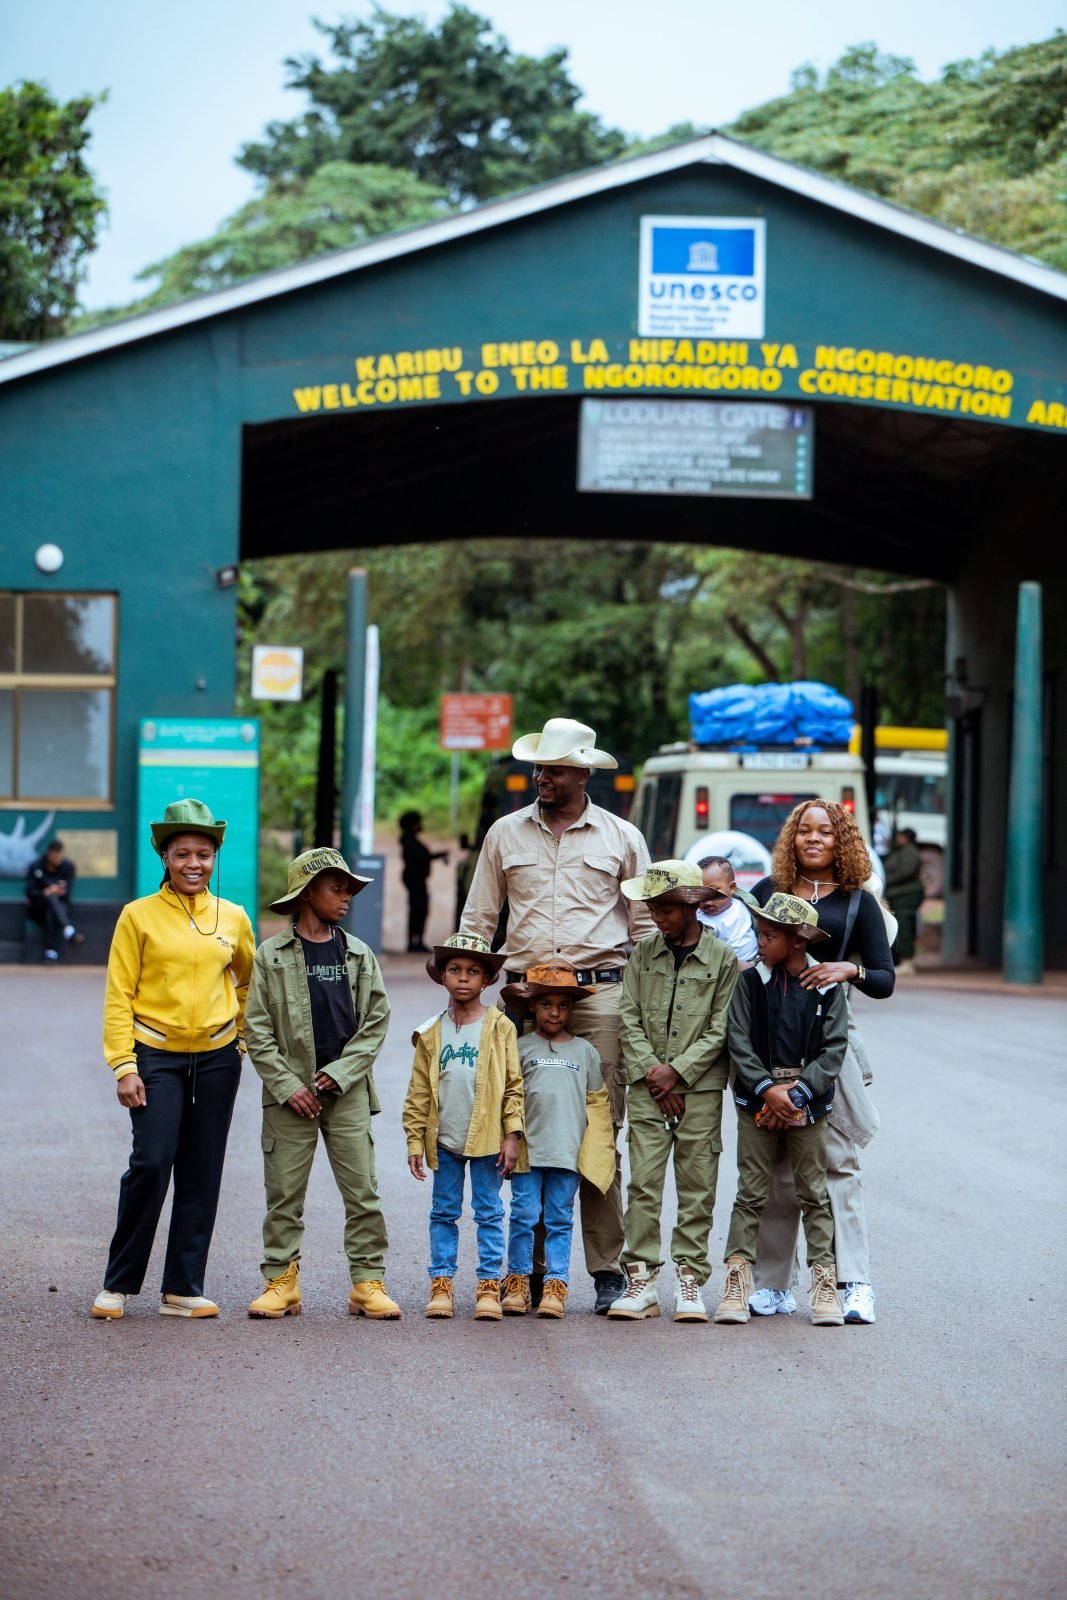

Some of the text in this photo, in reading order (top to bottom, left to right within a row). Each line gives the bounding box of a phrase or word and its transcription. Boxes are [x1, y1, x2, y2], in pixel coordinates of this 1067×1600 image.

[649, 283, 757, 301] unesco
[355, 339, 1014, 394] KARIBU ENEO LA HIFADHI YA NGORONGORO
[292, 363, 1067, 428] WELCOME TO THE NGORONGORO CONSERVATION AR
[720, 404, 788, 430] GATE
[302, 856, 332, 875] HAKUNA
